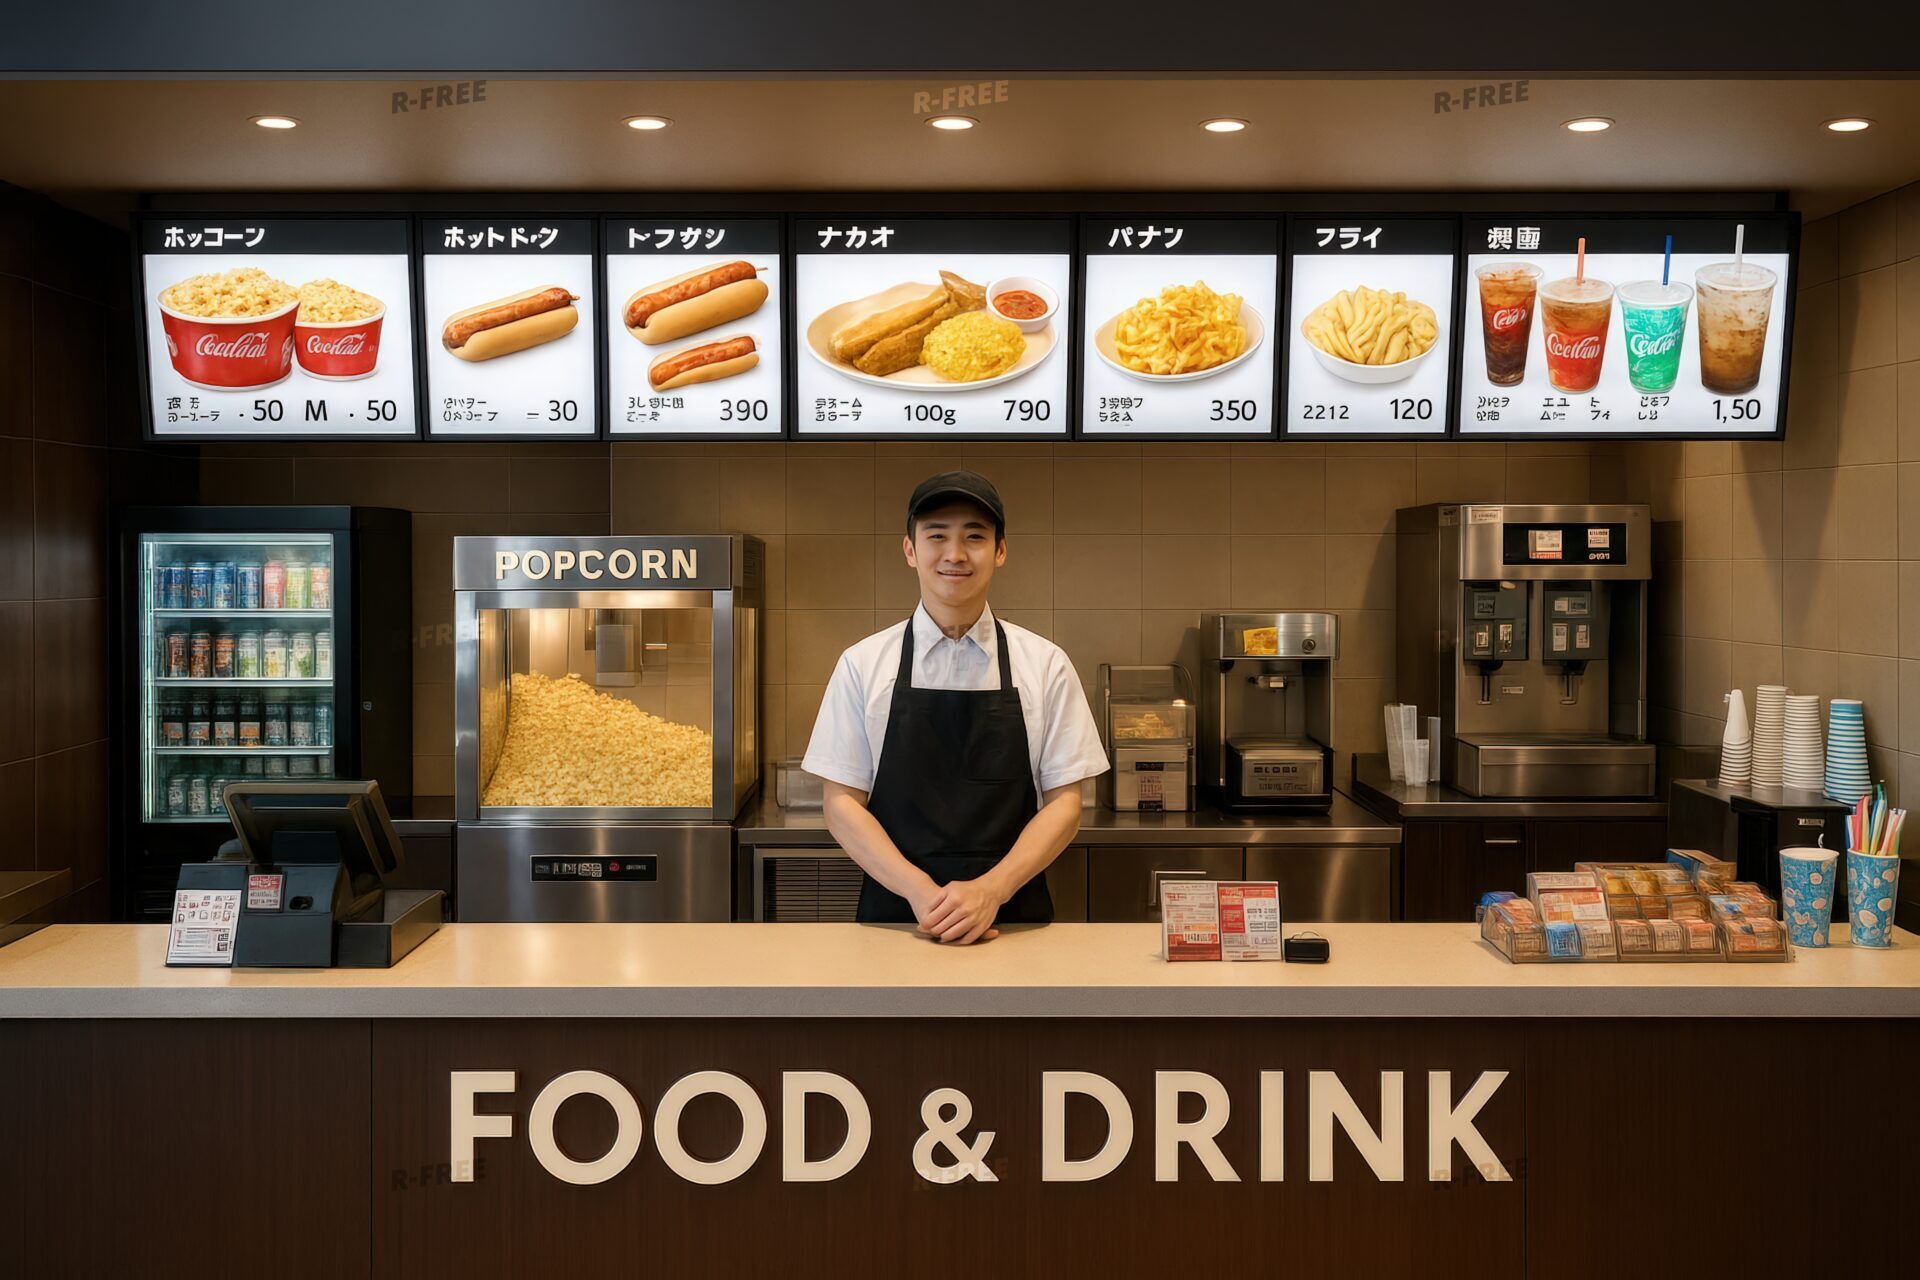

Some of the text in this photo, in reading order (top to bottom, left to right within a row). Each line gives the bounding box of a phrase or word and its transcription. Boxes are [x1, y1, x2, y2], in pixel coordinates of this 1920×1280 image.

[817, 225, 895, 249] ナカオ
[1108, 225, 1184, 249] パナン
[1316, 227, 1383, 250] フライ
[306, 399, 328, 422] M
[719, 399, 768, 422] 390
[904, 399, 1051, 426] 100g 790
[1210, 399, 1257, 421] 350
[1303, 398, 1433, 420] 2212 120
[1712, 398, 1761, 424] 1,50
[494, 548, 698, 581] POPCORN
[450, 1070, 1513, 1185] FOOD & DRINK
